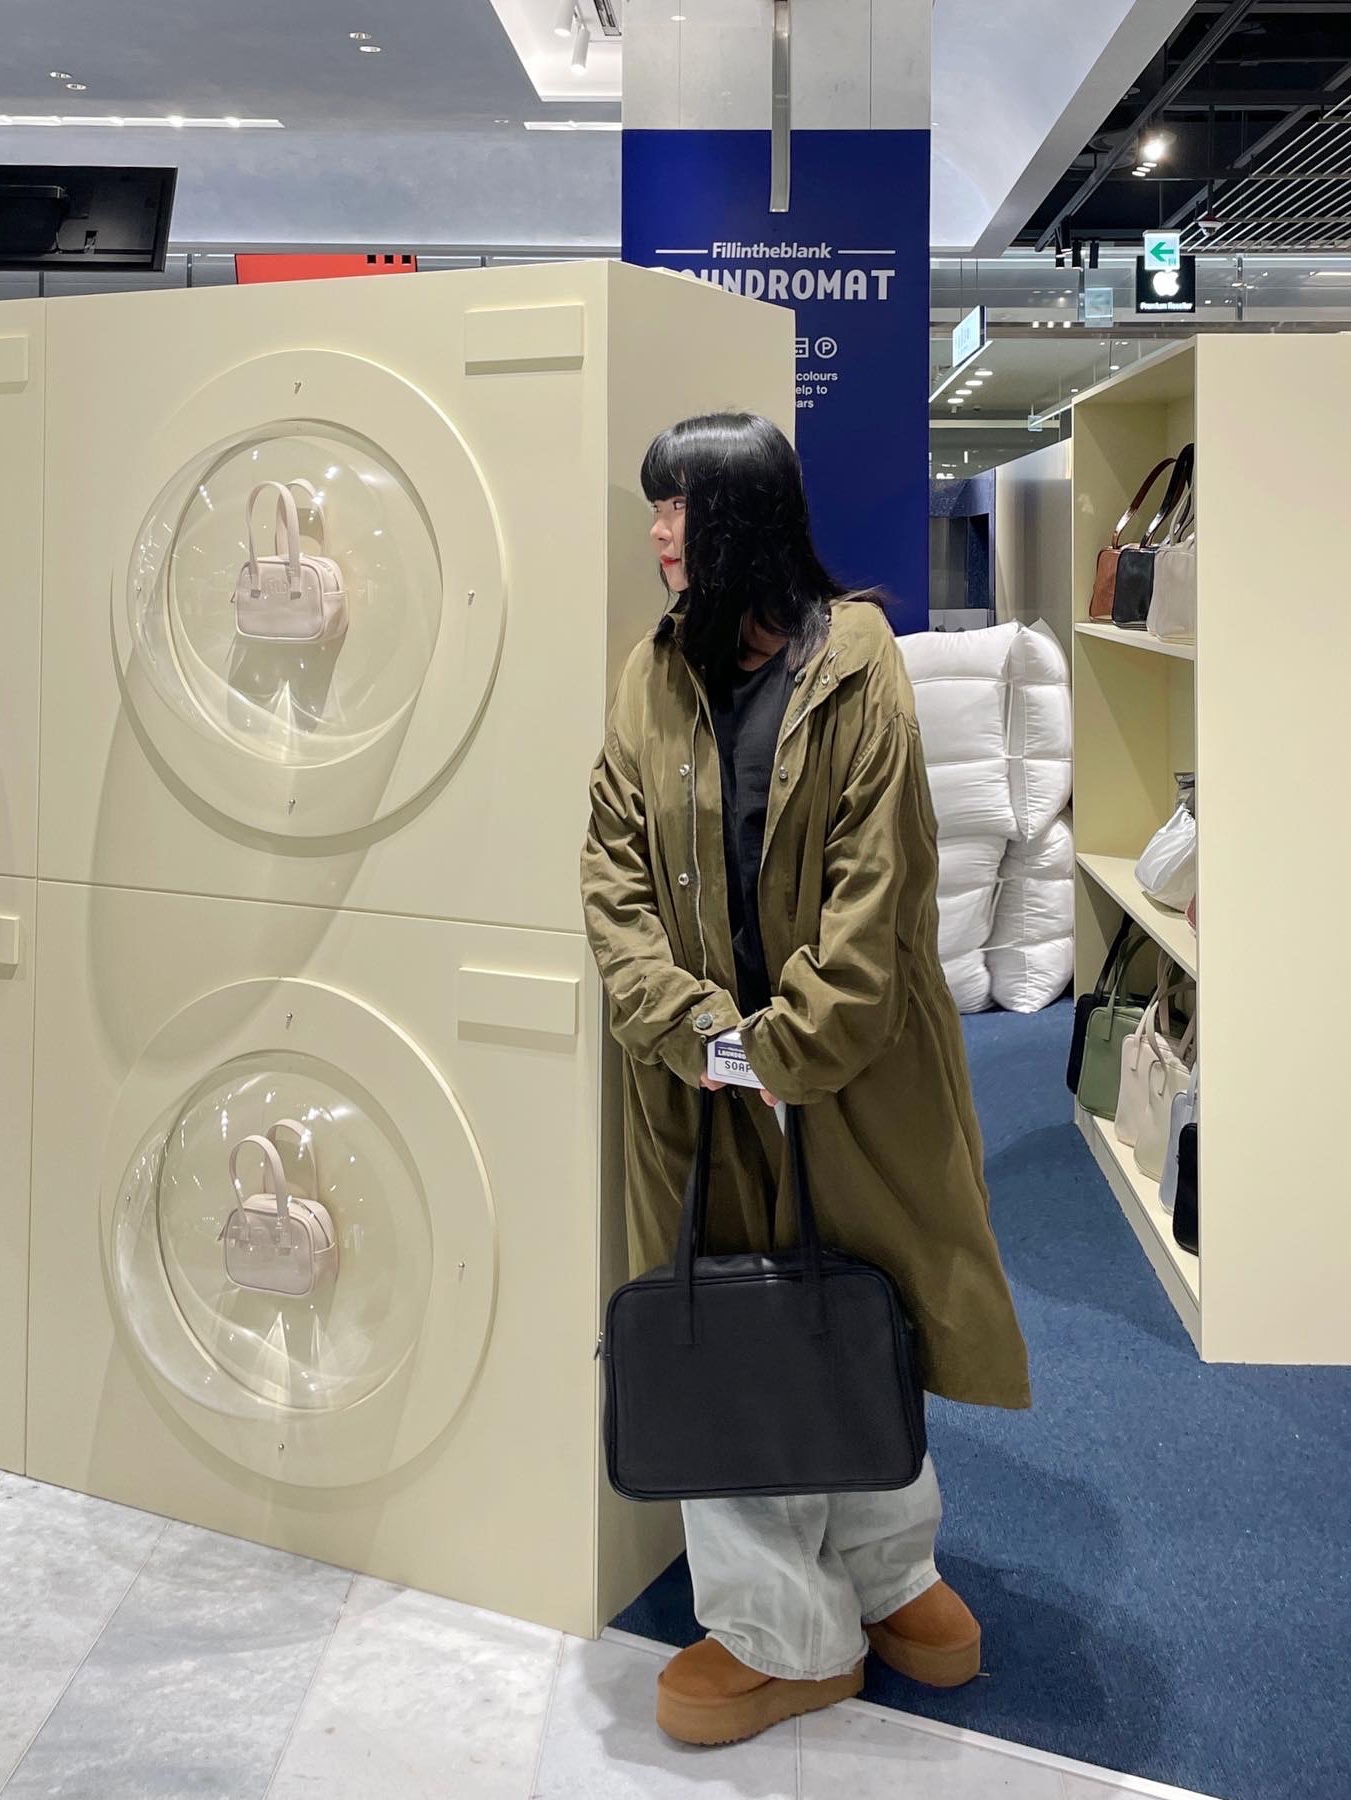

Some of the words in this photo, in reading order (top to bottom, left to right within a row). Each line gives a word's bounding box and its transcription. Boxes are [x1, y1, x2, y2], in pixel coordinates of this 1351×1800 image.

[712, 242, 832, 258] Fillintheblank
[680, 269, 895, 300] NDROMAT
[796, 371, 838, 381] colours
[816, 384, 828, 395] to
